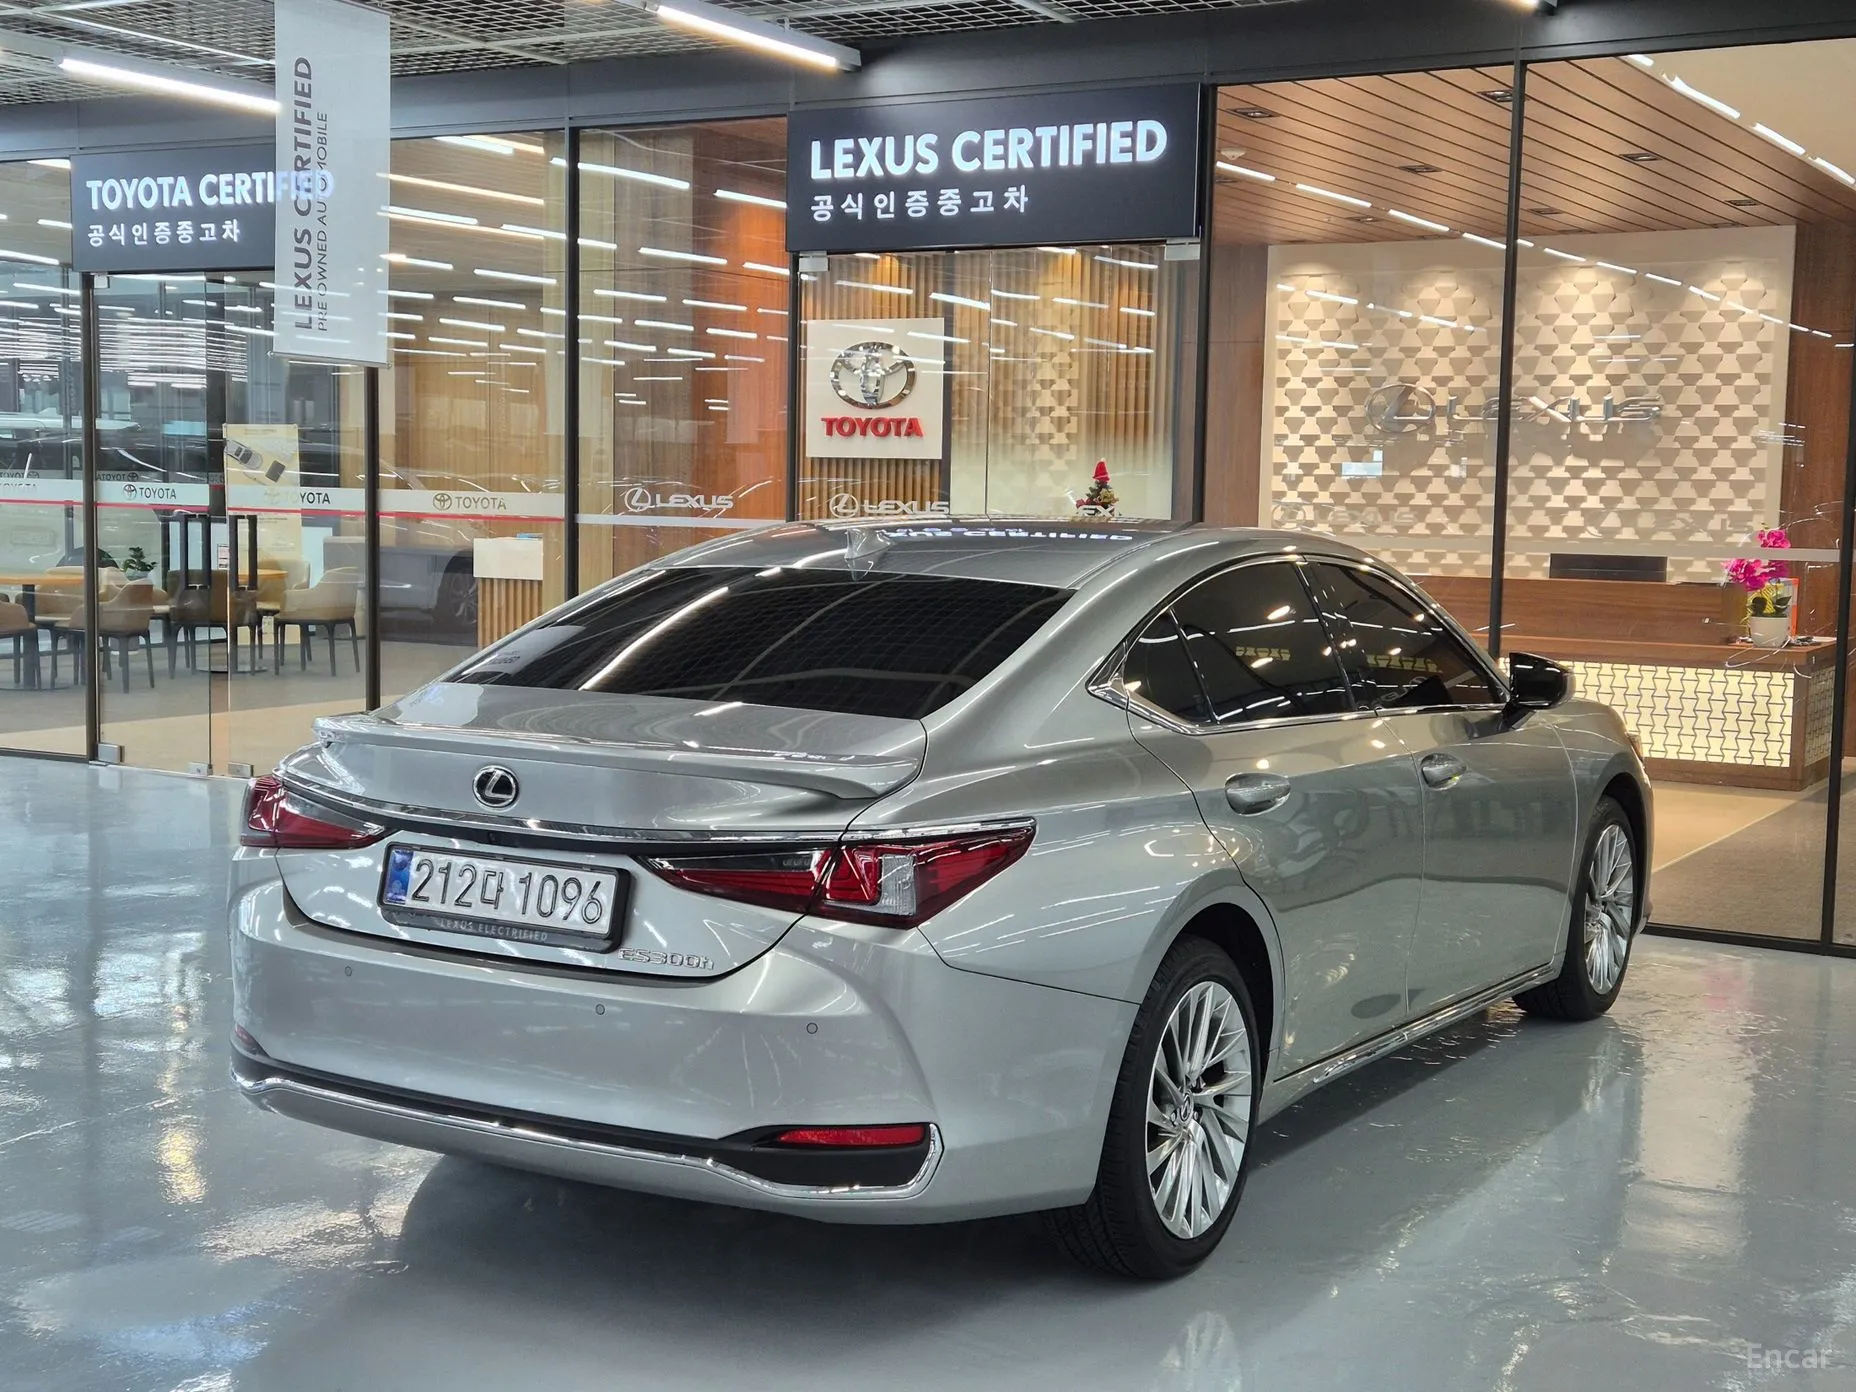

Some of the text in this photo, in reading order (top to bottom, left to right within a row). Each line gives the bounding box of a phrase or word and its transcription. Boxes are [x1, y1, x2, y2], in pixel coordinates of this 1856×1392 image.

[810, 119, 1169, 180] LEXUS CERTIFIED
[86, 170, 335, 210] TOYOTA CERTIFIED
[316, 231, 328, 297] OWNED
[294, 228, 313, 330] LEXUS
[317, 301, 328, 332] PRE
[821, 416, 924, 438] TOYOTA
[140, 486, 177, 500] TOYOTA
[454, 496, 507, 510] TOYOTA
[656, 493, 734, 510] LEXUS
[863, 499, 950, 515] LEXUS
[439, 918, 474, 931] LEXUS
